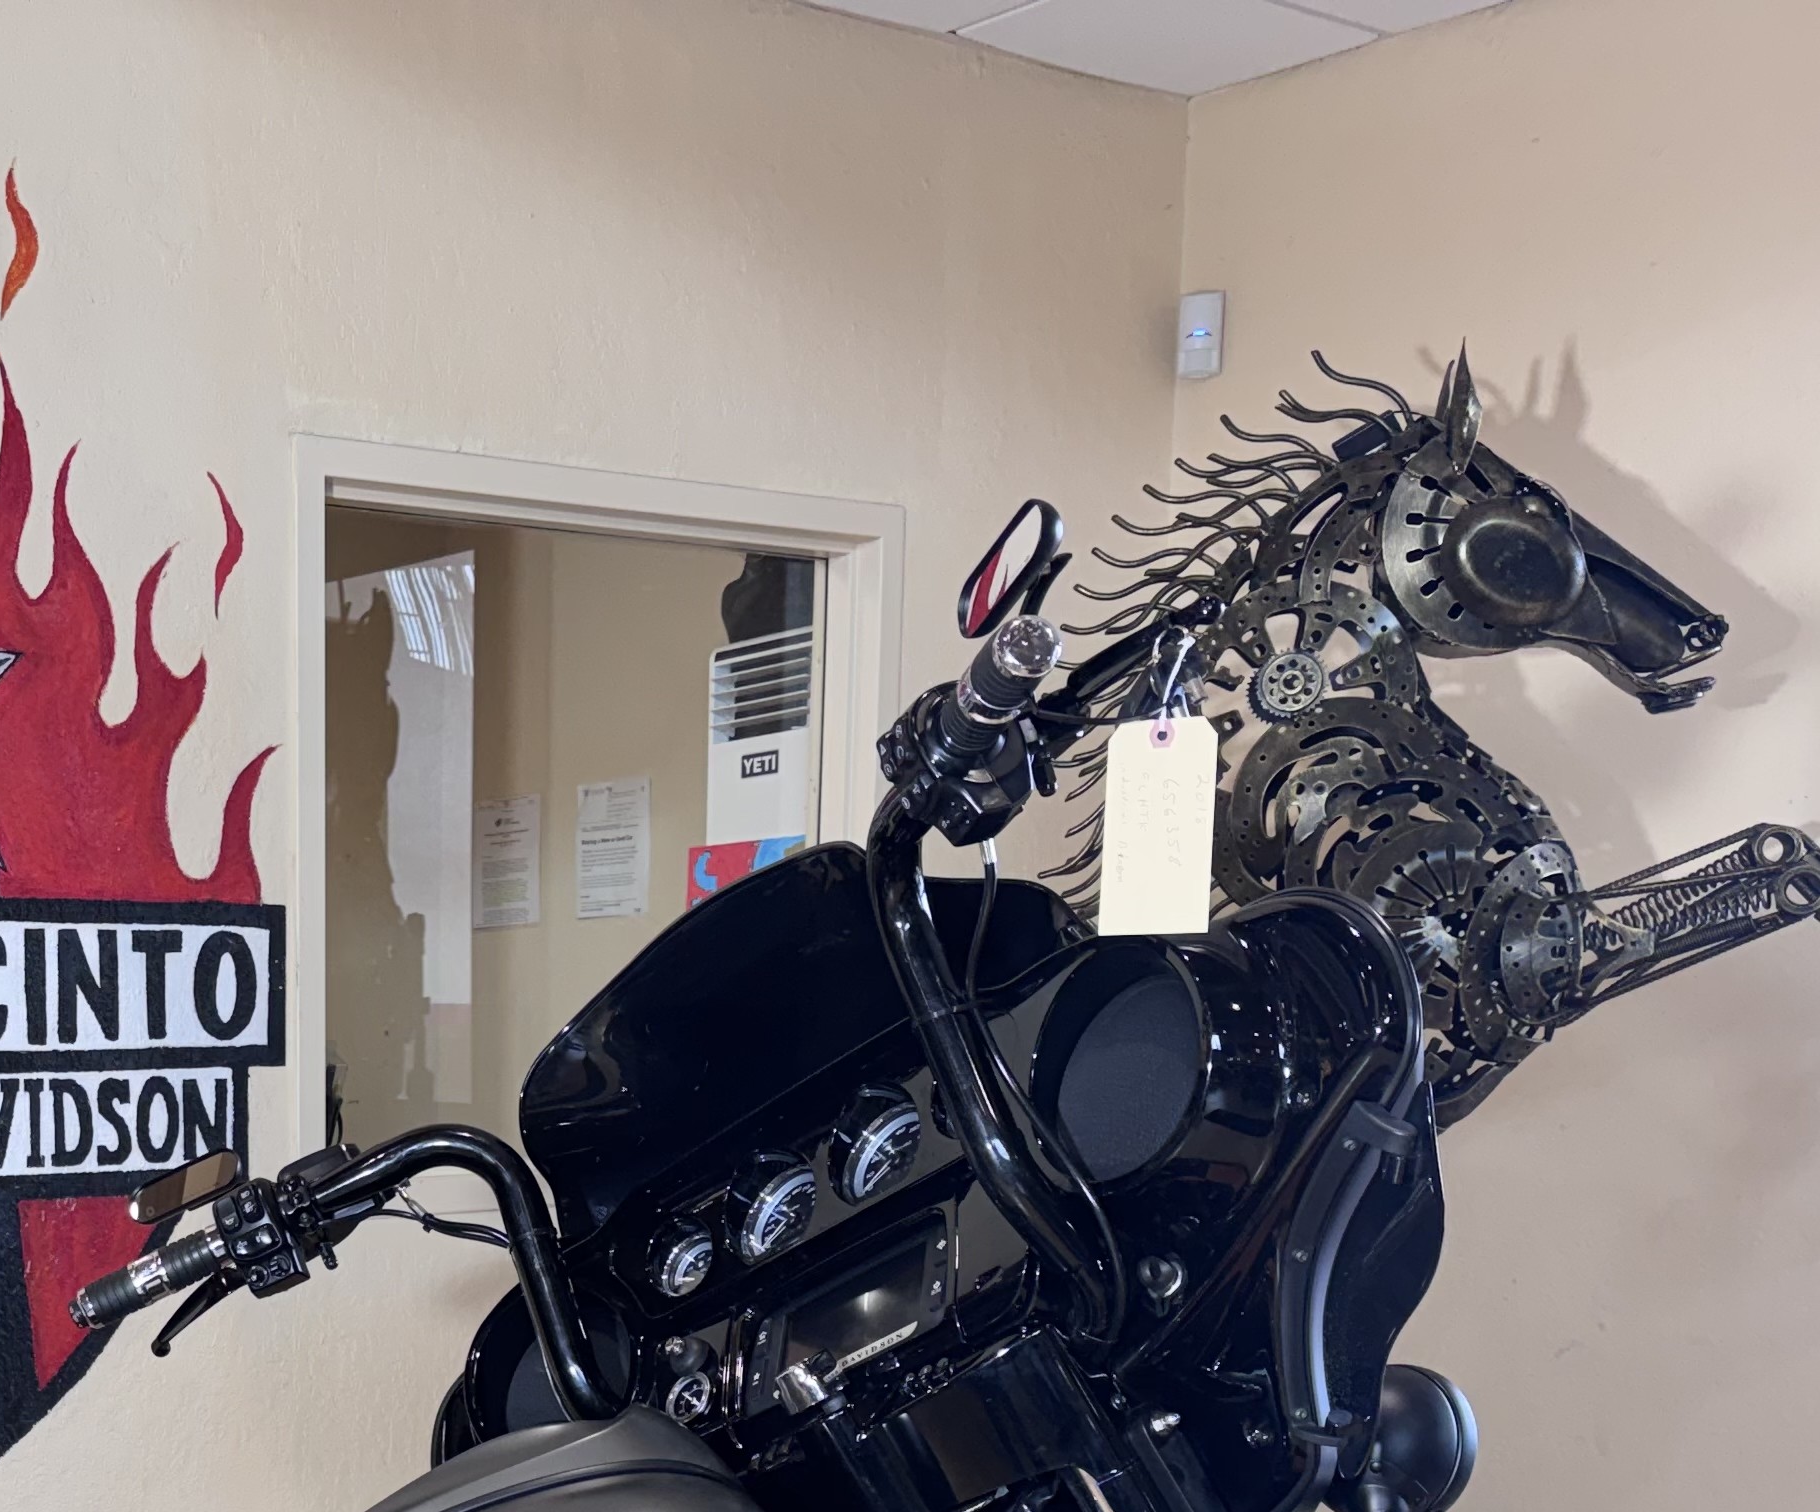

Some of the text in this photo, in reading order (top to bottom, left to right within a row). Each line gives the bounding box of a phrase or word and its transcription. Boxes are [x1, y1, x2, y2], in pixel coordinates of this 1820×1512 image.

[743, 754, 777, 776] YETI
[1162, 778, 1182, 868] 656358
[841, 1332, 903, 1367] DAVIDSON
